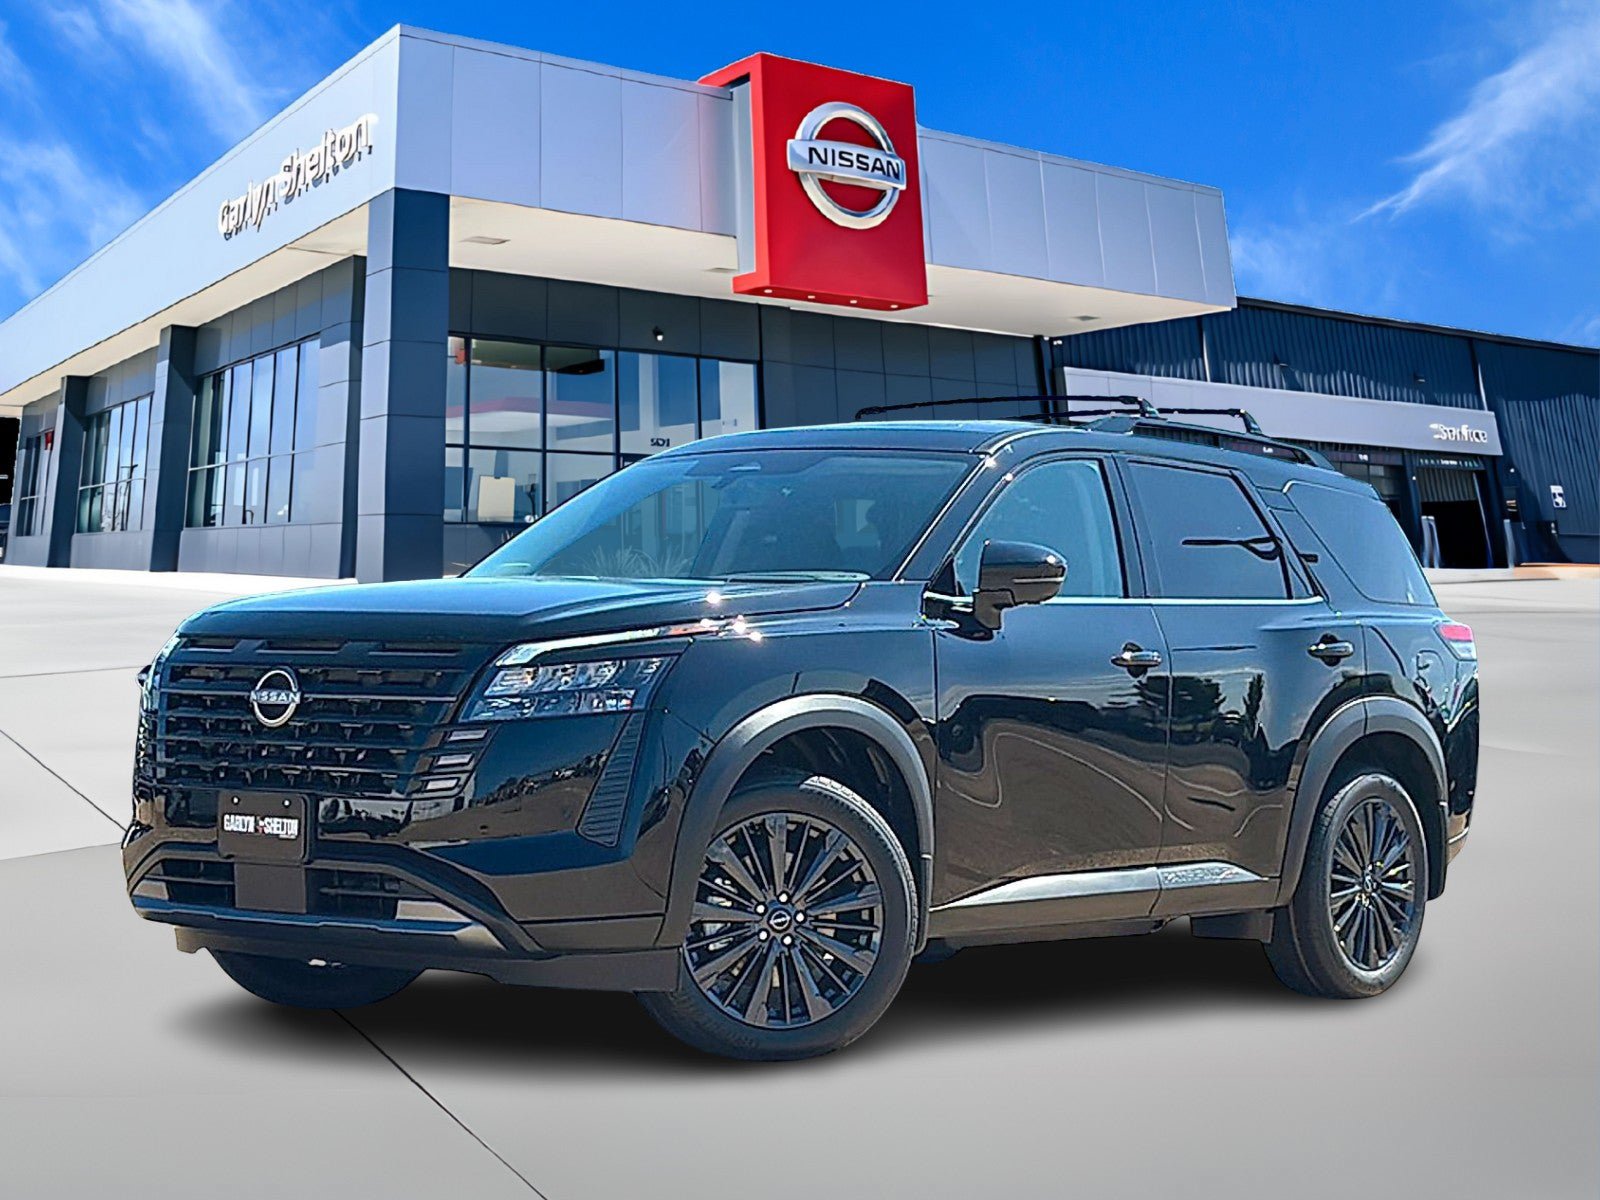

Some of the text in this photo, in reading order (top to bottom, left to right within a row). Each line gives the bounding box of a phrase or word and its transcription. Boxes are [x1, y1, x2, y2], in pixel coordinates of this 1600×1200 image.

[279, 118, 373, 205] Shelton
[808, 146, 901, 180] NISSAN
[1431, 423, 1488, 443] Service
